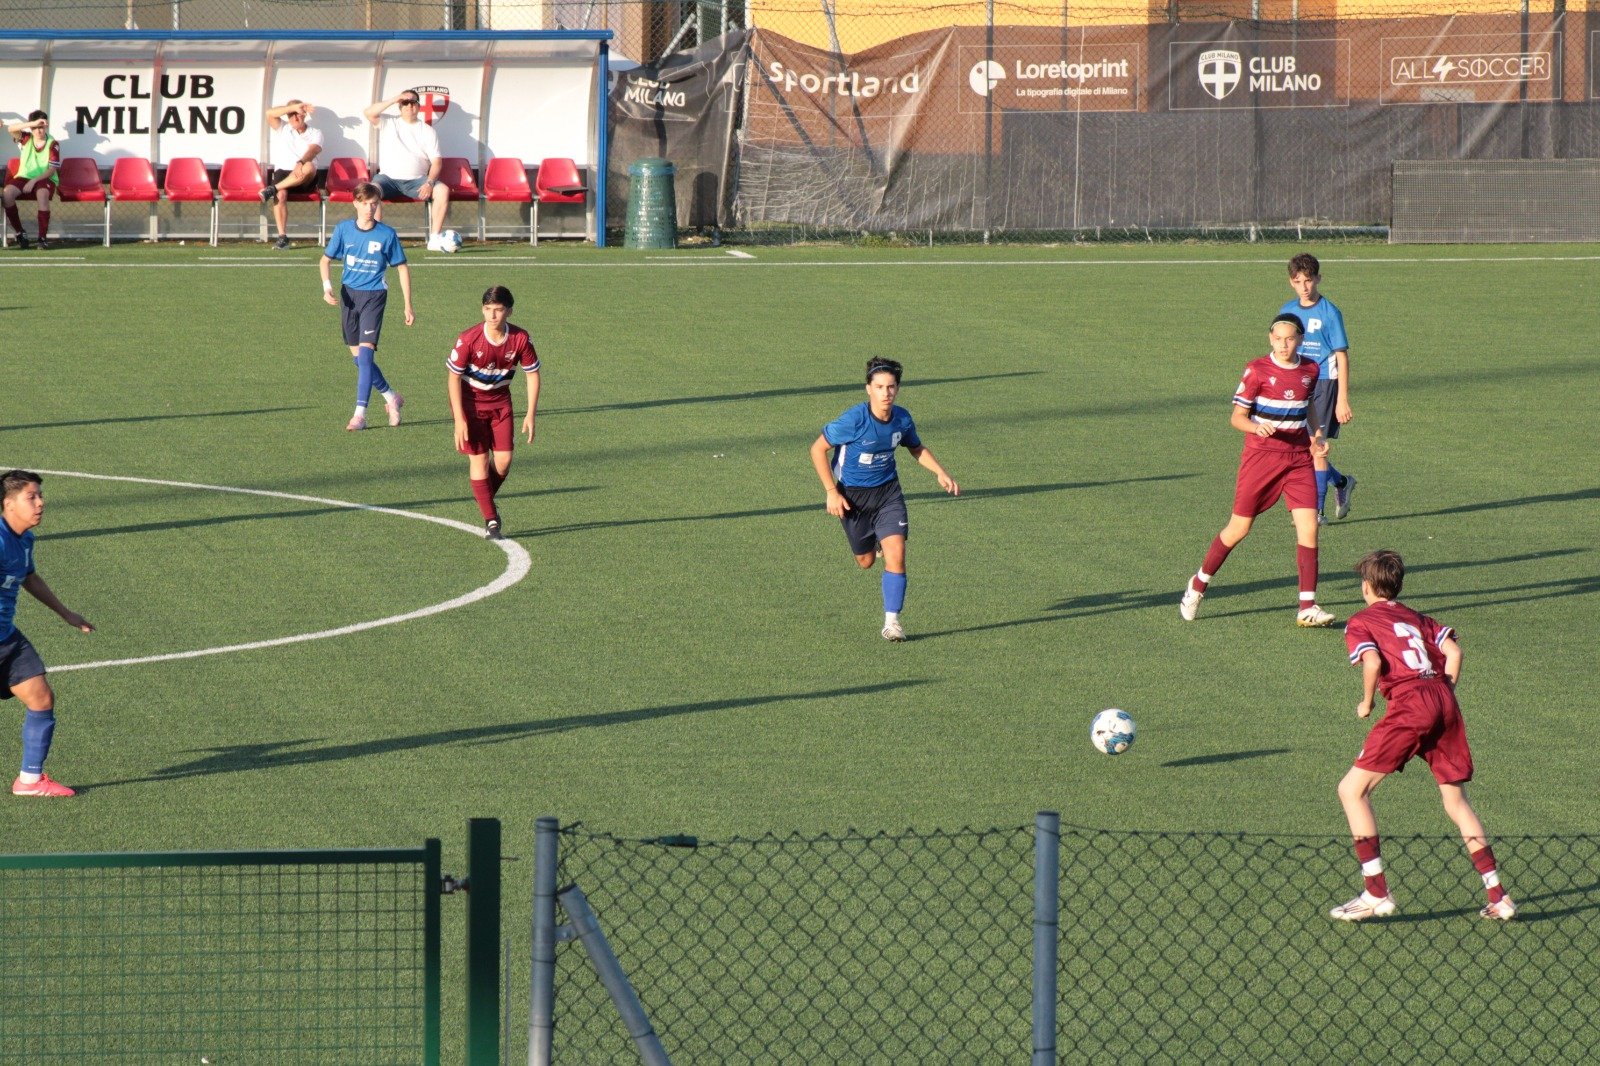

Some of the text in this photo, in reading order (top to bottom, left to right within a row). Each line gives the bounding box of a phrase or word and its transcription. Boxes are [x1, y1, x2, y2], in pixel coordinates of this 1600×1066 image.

[1201, 52, 1239, 60] CLUB MILANO
[1249, 56, 1296, 74] CLUB
[769, 61, 919, 98] Sportland
[1016, 59, 1128, 83] Loretoprint
[103, 74, 214, 99] CLUB
[1016, 88, 1026, 96] La
[1027, 87, 1063, 97] tipografia
[1093, 86, 1101, 95] di
[1102, 86, 1128, 95] Milano
[1249, 74, 1321, 92] MILANO
[624, 86, 686, 107] MILANO
[75, 106, 246, 134] MILANO
[367, 241, 382, 254] P
[1307, 318, 1322, 334] P
[1393, 622, 1432, 670] 3
